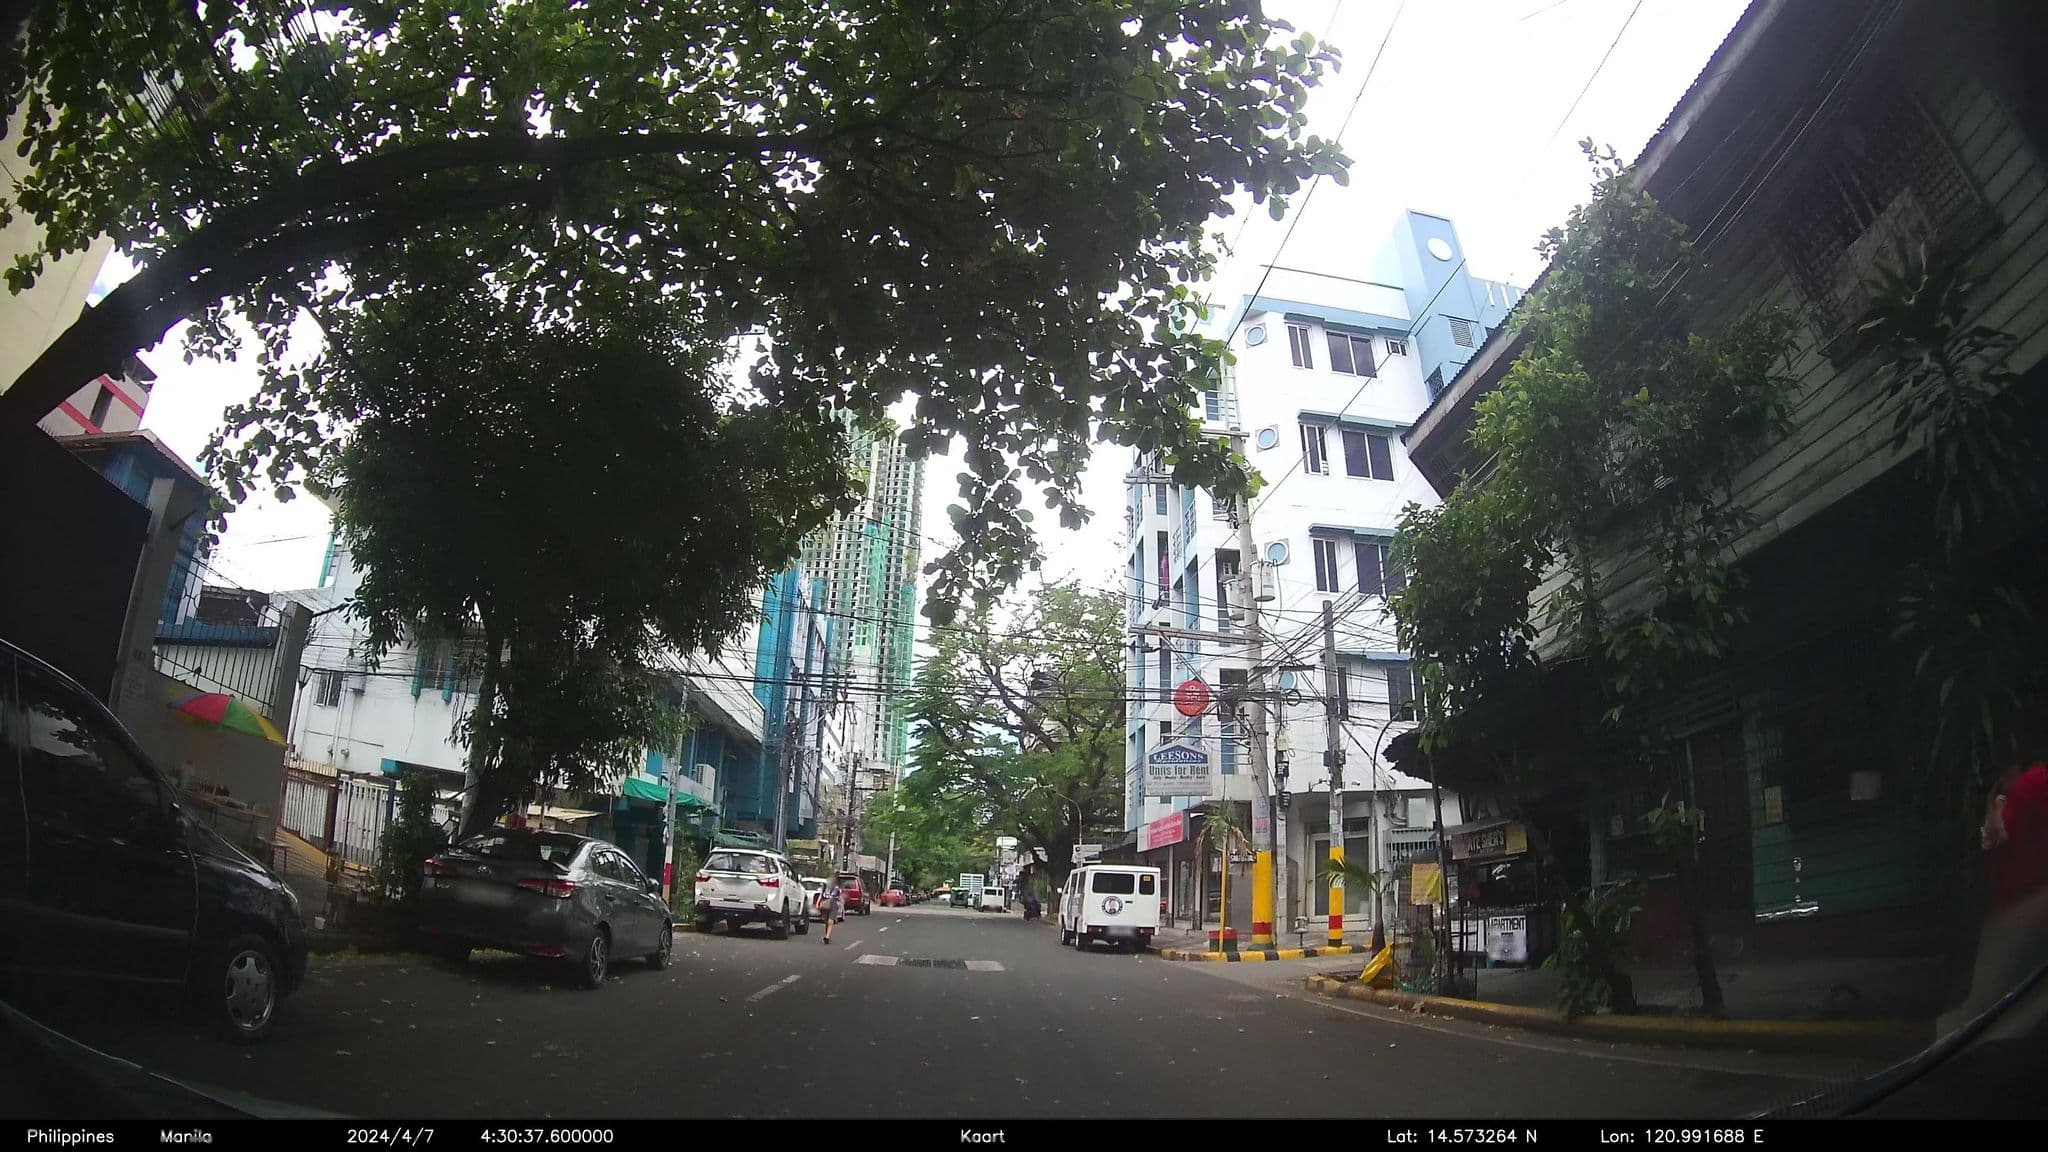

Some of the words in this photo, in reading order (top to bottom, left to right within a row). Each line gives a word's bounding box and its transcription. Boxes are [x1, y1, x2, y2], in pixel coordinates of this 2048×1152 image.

[1153, 750, 1204, 761] LEESONS
[1149, 765, 1172, 776] Units
[1174, 765, 1187, 776] for
[1190, 765, 1209, 776] Rent
